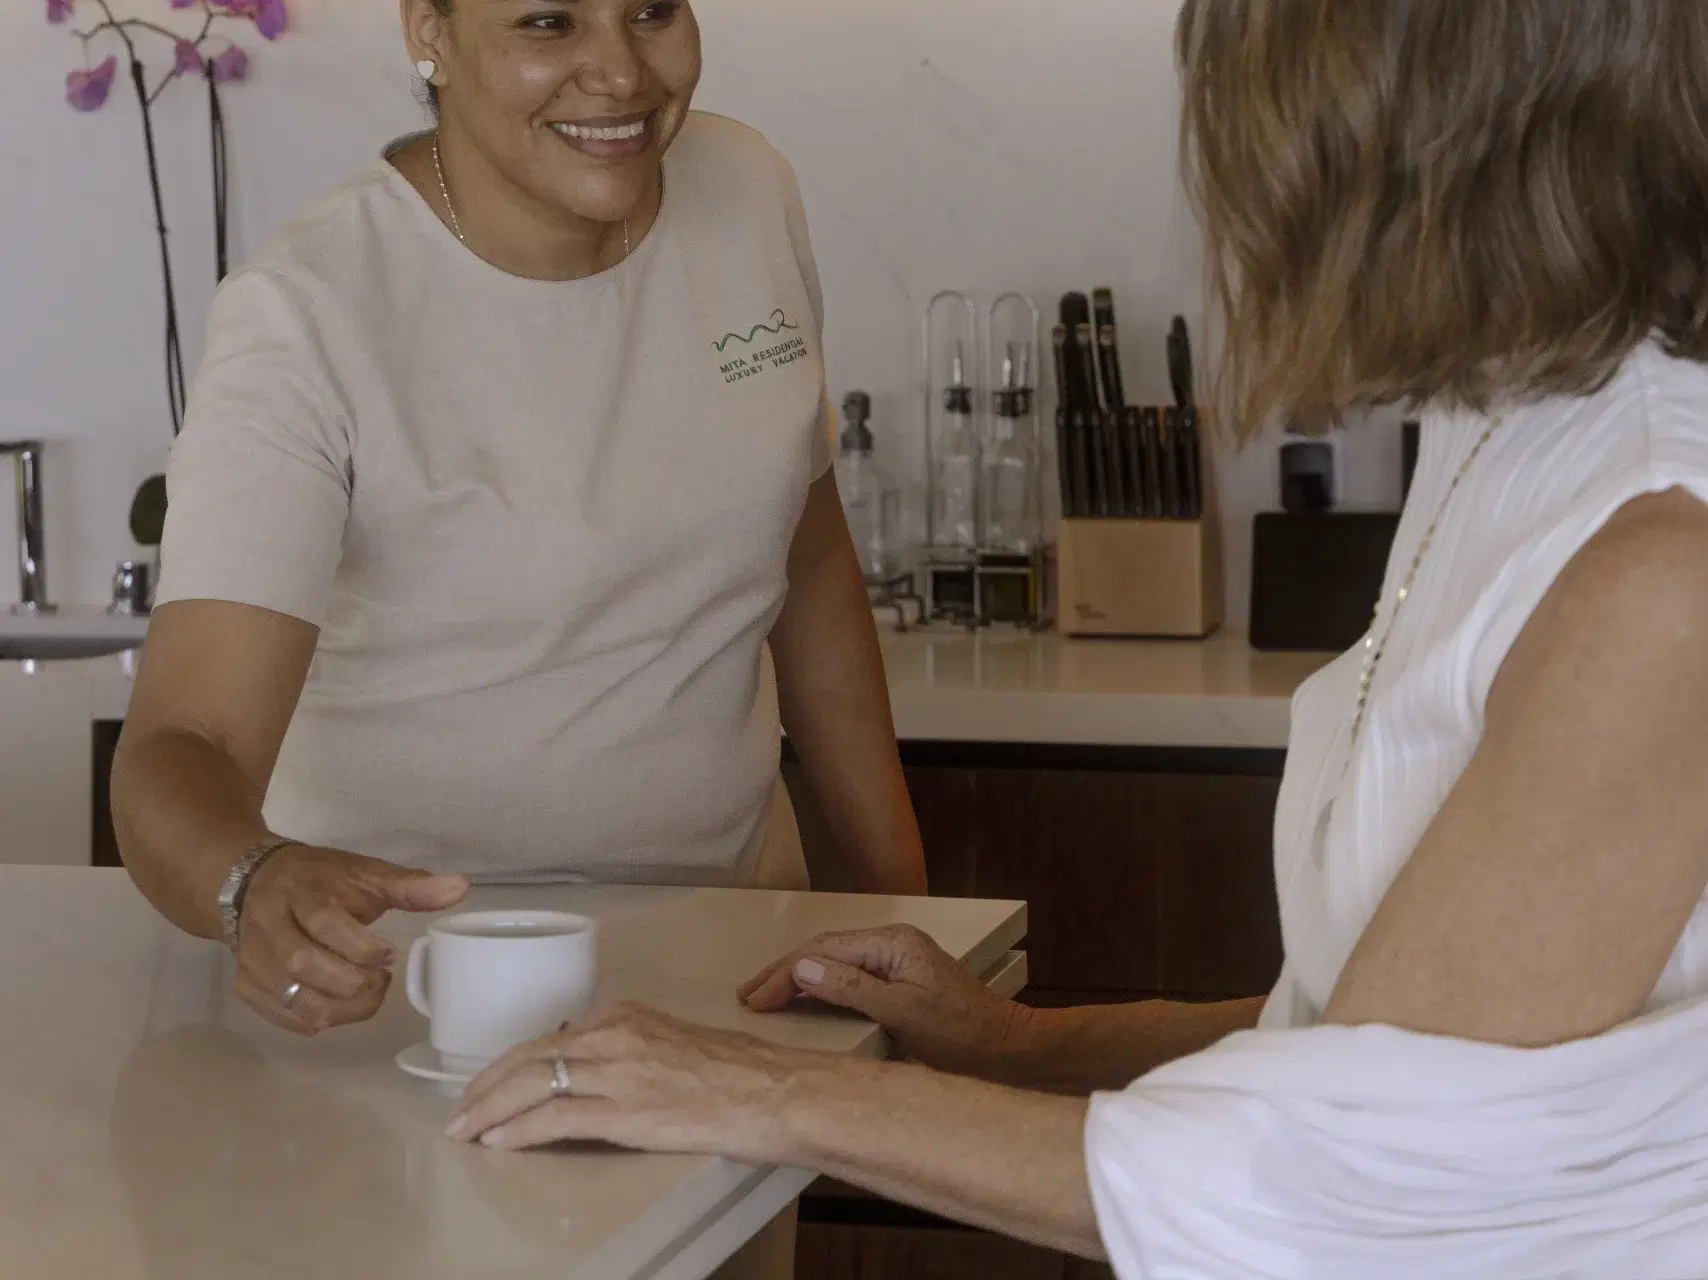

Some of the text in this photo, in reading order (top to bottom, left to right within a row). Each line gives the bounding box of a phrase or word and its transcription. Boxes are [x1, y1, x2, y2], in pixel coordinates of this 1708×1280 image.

[719, 336, 804, 374] MITA RESIDENTIAL
[724, 364, 764, 383] LUXURY
